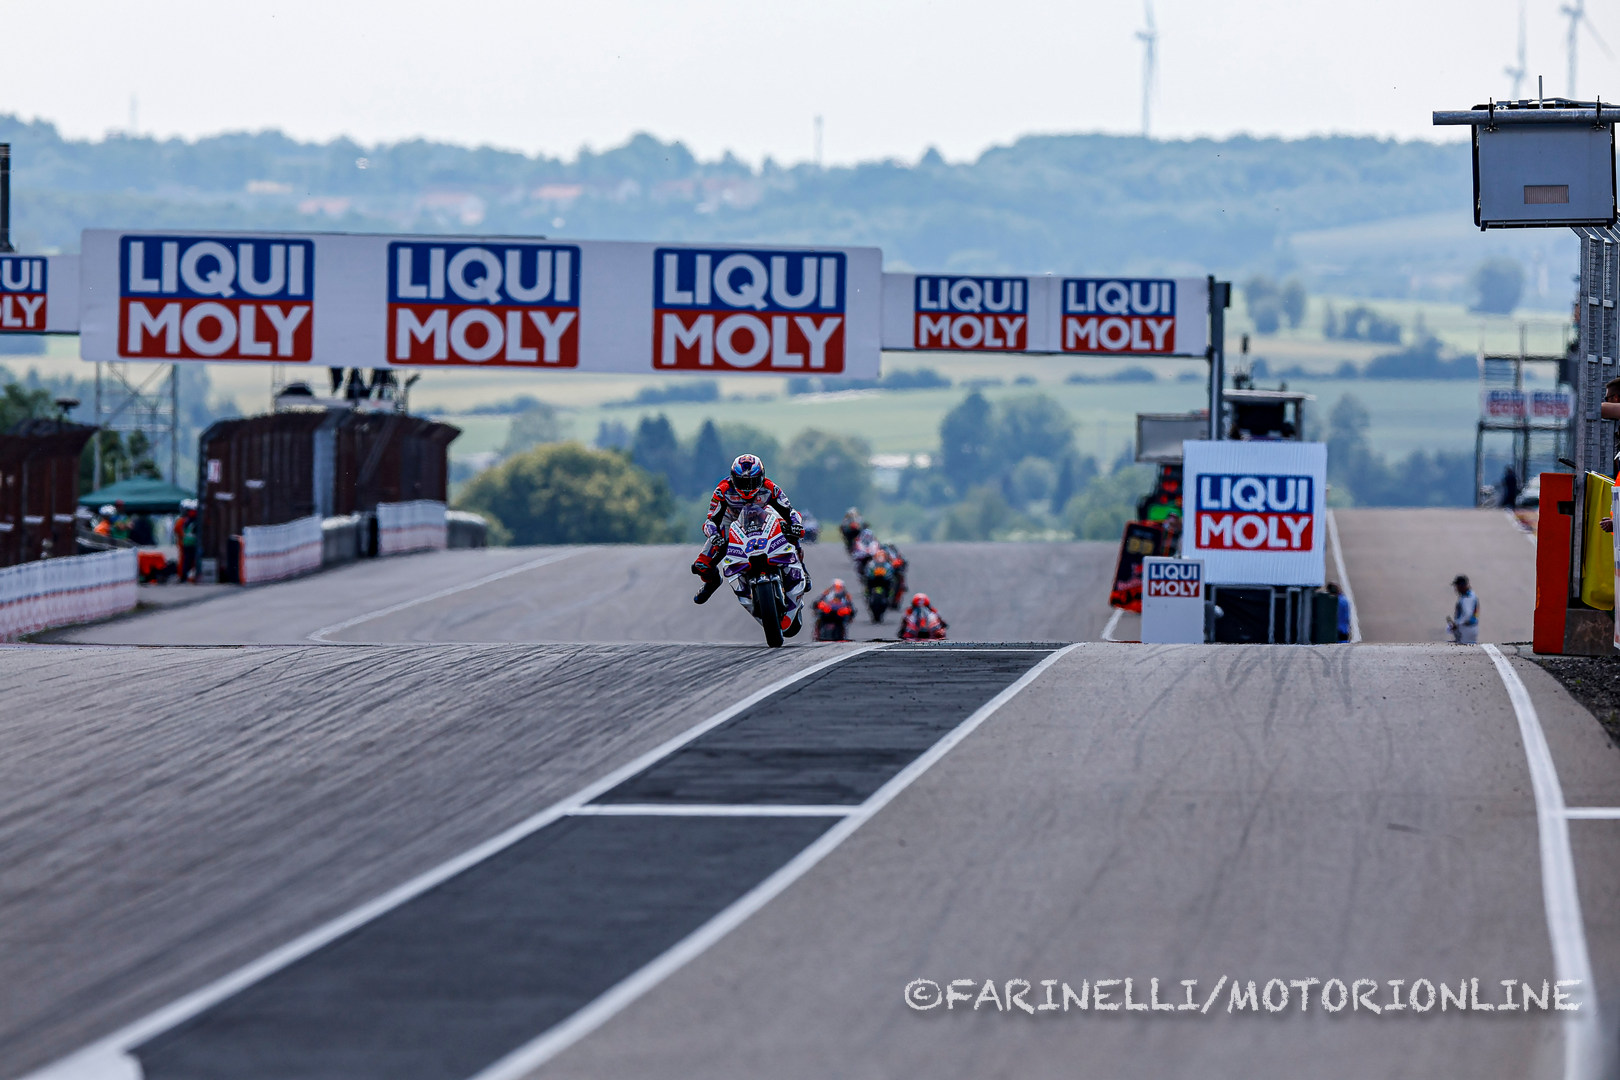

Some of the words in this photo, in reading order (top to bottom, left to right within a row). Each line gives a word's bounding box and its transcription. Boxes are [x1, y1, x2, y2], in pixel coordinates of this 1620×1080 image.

[0, 260, 42, 291] UI
[130, 243, 304, 297] LIQUI
[398, 249, 570, 303] LIQUI
[663, 253, 835, 309] LIQUI
[0, 295, 44, 328] LY
[921, 280, 1021, 312] LIQUI
[1068, 283, 1170, 314] LIQUI
[128, 302, 310, 356] MOLY
[396, 308, 575, 362] MOLY
[662, 314, 841, 369] MOLY
[920, 316, 1024, 348] MOLY
[1067, 319, 1172, 350] MOLY
[1201, 478, 1309, 512] LIQUI
[745, 538, 768, 554] 89
[1200, 514, 1310, 549] MOLY
[1150, 580, 1199, 596] MOLY
[1151, 564, 1198, 580] LIQUI
